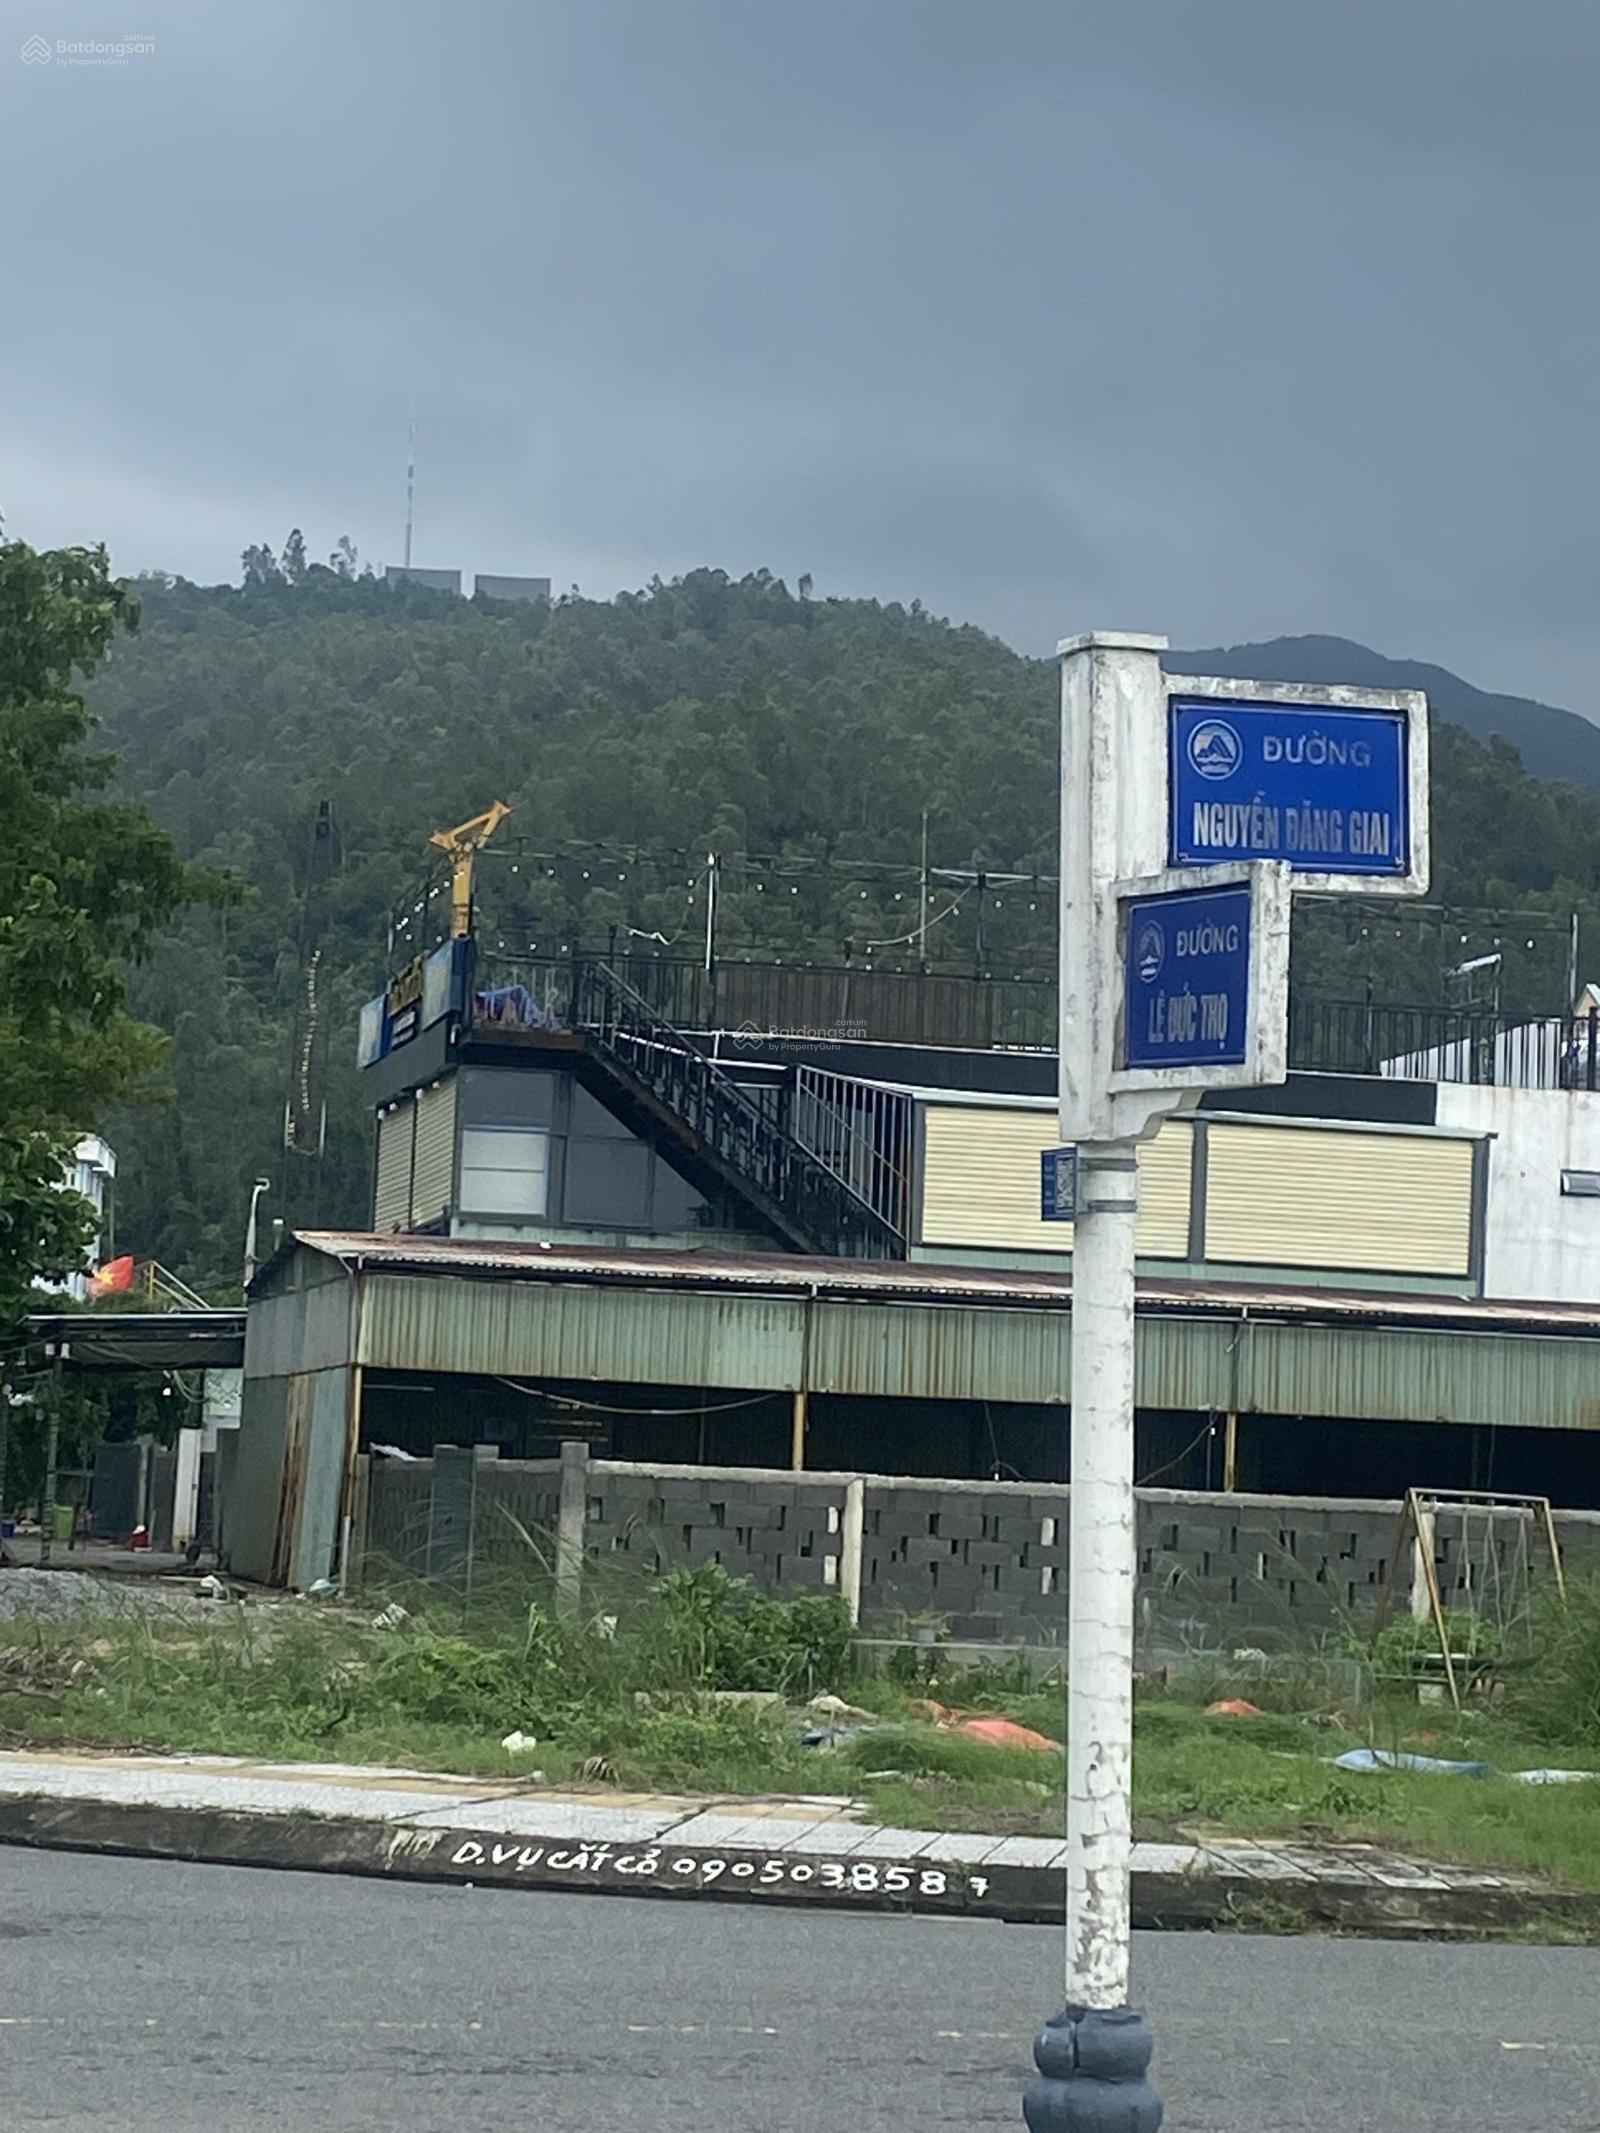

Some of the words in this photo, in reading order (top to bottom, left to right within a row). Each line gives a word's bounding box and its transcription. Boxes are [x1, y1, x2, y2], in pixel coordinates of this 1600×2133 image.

[1263, 730, 1371, 767] ĐƯỜNG
[1193, 790, 1279, 849] NGUYỄN
[1350, 810, 1390, 856] GIAI
[1176, 917, 1239, 957] ĐƯỜNG
[1148, 989, 1164, 1043] LÊ
[1168, 982, 1198, 1043] ĐỨC
[1201, 993, 1229, 1050] THỌ
